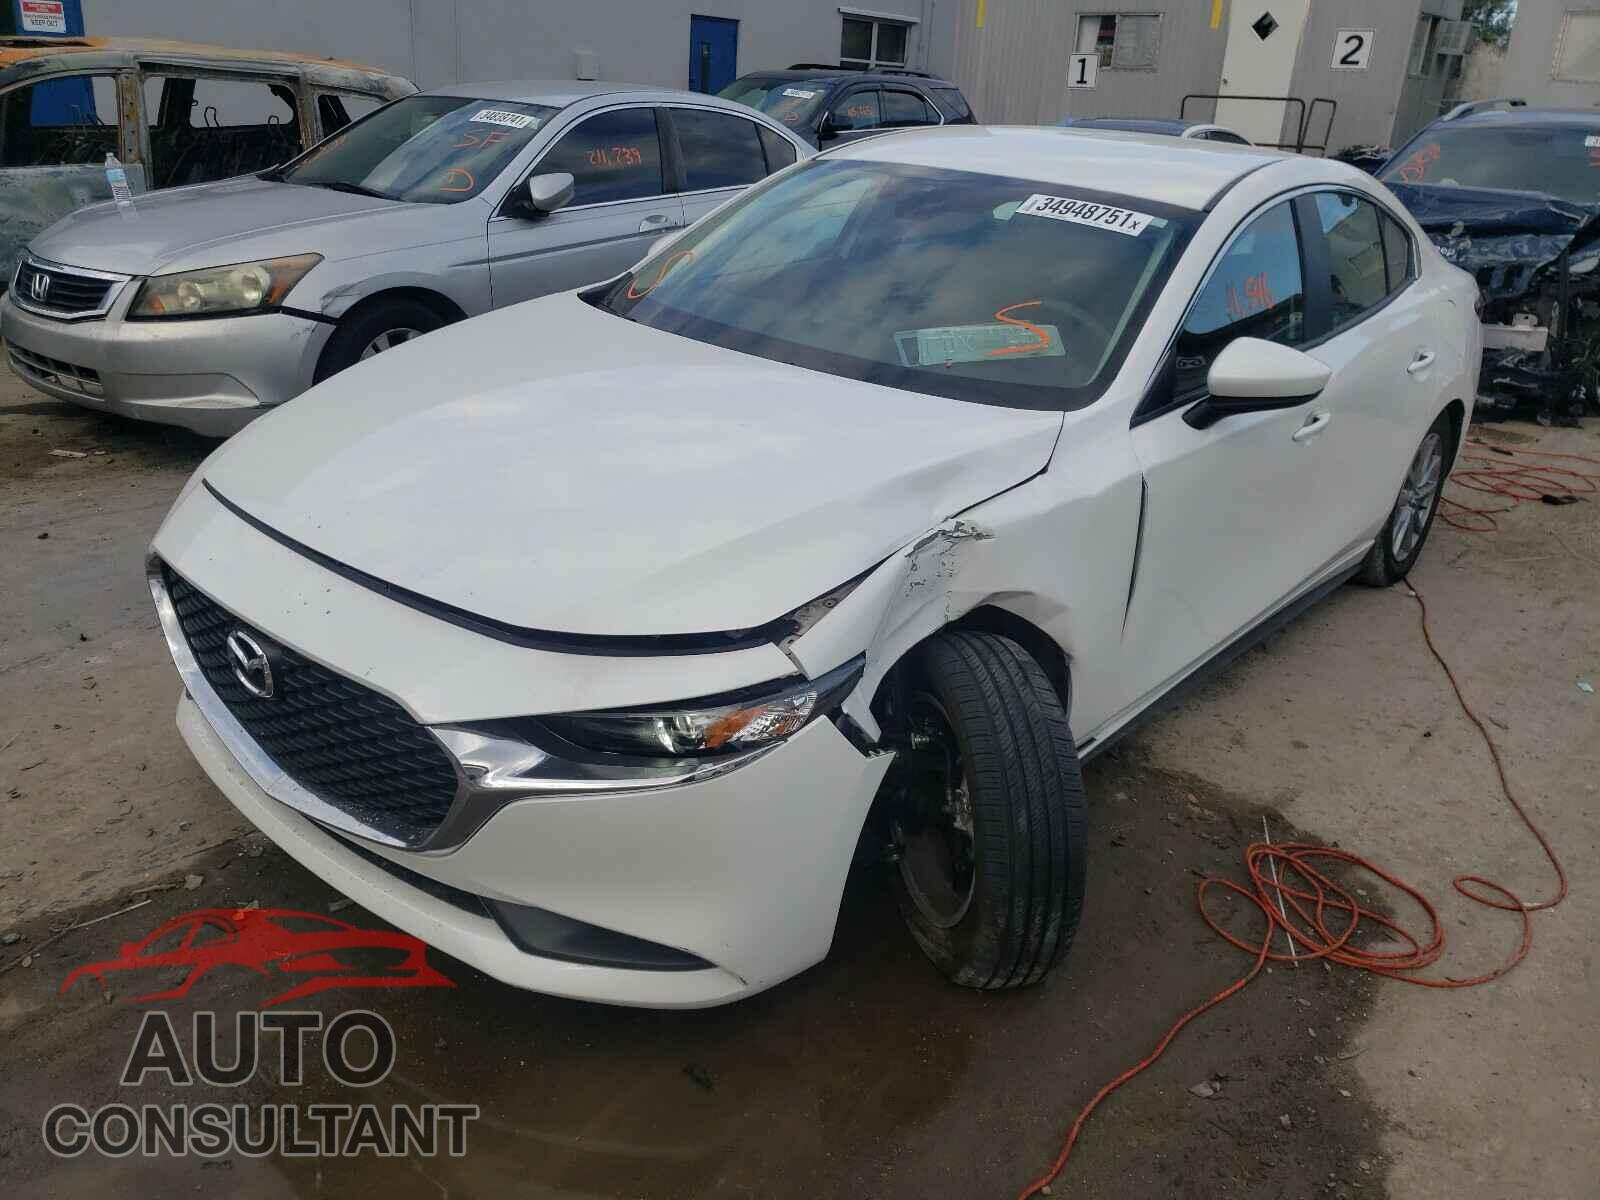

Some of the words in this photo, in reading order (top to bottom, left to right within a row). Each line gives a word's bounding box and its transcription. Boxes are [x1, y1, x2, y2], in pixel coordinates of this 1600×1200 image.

[1340, 34, 1364, 65] 2
[1076, 57, 1088, 84] 1
[984, 299, 1050, 357] S
